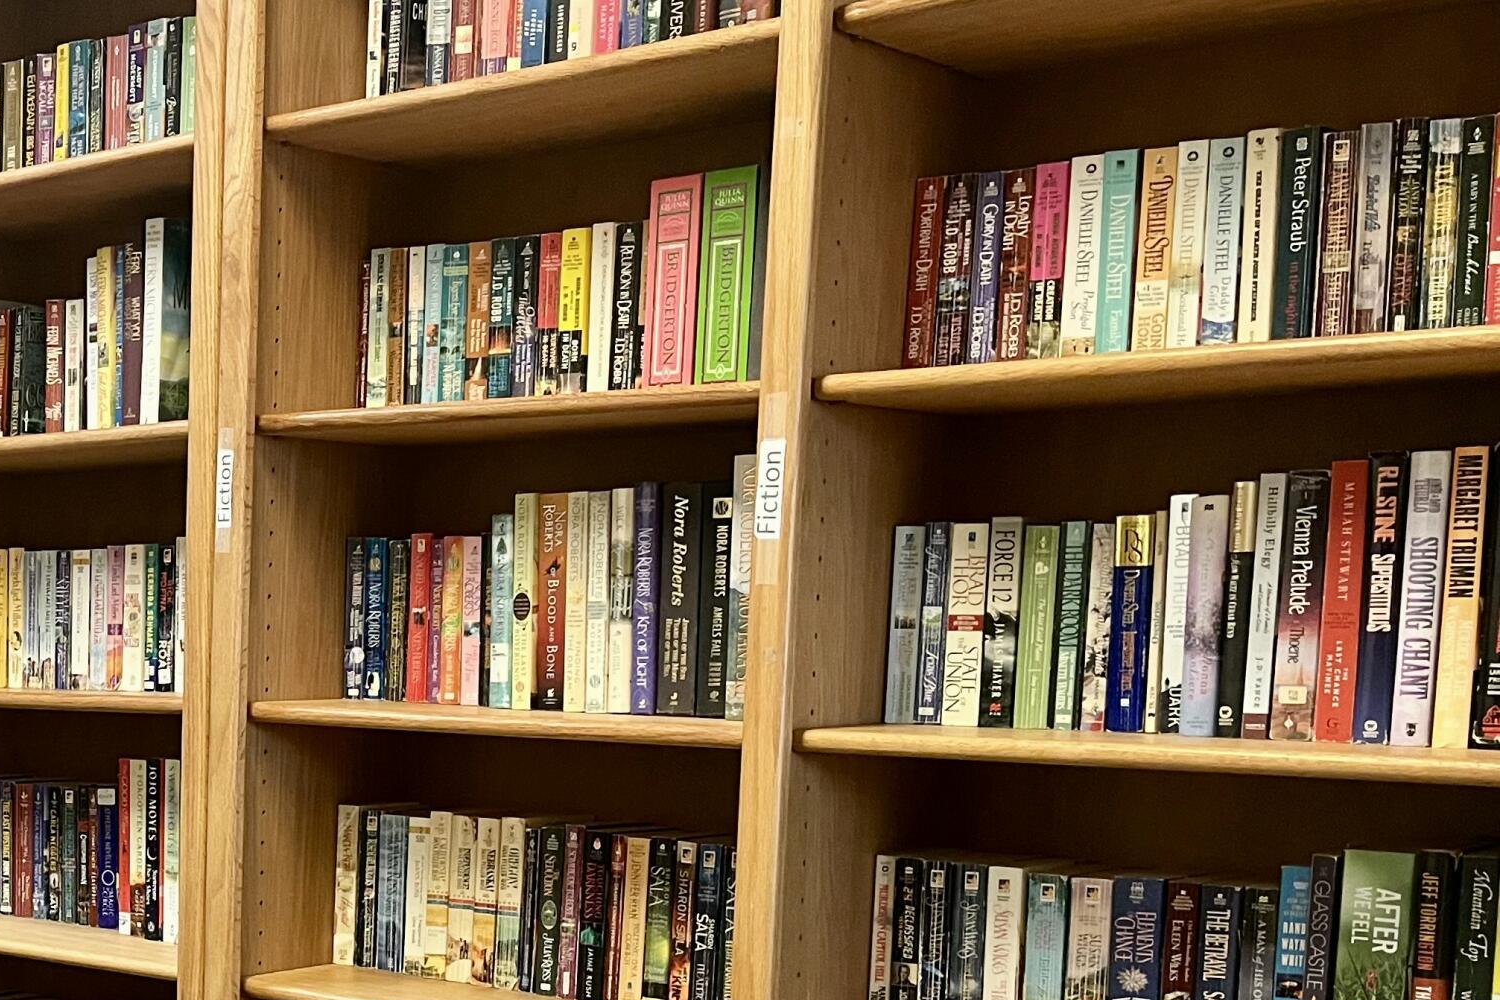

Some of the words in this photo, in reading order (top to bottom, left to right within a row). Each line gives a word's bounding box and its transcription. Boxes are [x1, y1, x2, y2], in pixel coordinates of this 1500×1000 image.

[1292, 157, 1311, 196] Peter
[1078, 190, 1098, 248] DANIELLE
[1108, 194, 1132, 260] DANIELLE
[1146, 175, 1173, 237] DANIELLE
[1217, 175, 1234, 235] DANIELLE
[1290, 199, 1309, 252] Straub
[1003, 215, 1016, 250] DEATH
[1215, 238, 1229, 274] STEEL
[133, 251, 142, 274] FERN
[943, 243, 957, 274] ROBB
[663, 251, 680, 365] BRIDGERTON
[715, 247, 734, 365] BRIDGERTON
[970, 324, 983, 358] ROBB
[1008, 315, 1022, 358] ROBB
[46, 347, 62, 385] MICHAELS
[217, 453, 231, 523] Fiction
[757, 450, 782, 534] Fiction
[1263, 487, 1278, 534] Hillbilly
[1342, 482, 1355, 535] MARIAH
[1453, 454, 1483, 531] MARGARET
[543, 504, 556, 553] ROBERTS
[555, 510, 566, 546] NORA
[673, 495, 689, 538] Nora
[715, 526, 729, 552] NORA
[1293, 505, 1317, 557] Vienna
[1374, 496, 1396, 543] STINE
[638, 528, 653, 554] NORA
[992, 530, 1015, 582] FORCE
[1262, 538, 1275, 570] Elegy
[635, 557, 652, 605] ROBERTS
[672, 542, 689, 606] Roberts
[713, 556, 727, 597] ROBERTS
[951, 559, 969, 609] THOR
[968, 554, 986, 606] BRAD
[1289, 558, 1313, 614] Prelude
[1337, 540, 1350, 600] STEWART
[1405, 536, 1439, 630] SHOOTING
[1448, 538, 1477, 598] TRUMAN
[369, 582, 381, 608] NORA
[548, 579, 559, 628] BLOOD
[992, 589, 1012, 603] 12
[1367, 554, 1396, 633] SUPERSTITIOUS
[366, 611, 381, 648] ROBERTS
[712, 606, 724, 637] ANGELS
[546, 645, 558, 679] BONE
[710, 639, 722, 657] FALL
[962, 646, 977, 693] STATE
[1400, 638, 1431, 699] CHANT
[636, 656, 647, 688] LIGHT
[945, 652, 962, 713] UNION
[991, 661, 1003, 698] THAYER
[149, 766, 157, 795] JOJO
[148, 800, 157, 841] MOYES
[650, 866, 665, 906] SALA
[676, 870, 688, 922] SHARON
[1311, 880, 1330, 930] GLASS
[1354, 886, 1372, 911] WE
[1422, 872, 1438, 895] JEFF
[1469, 869, 1493, 930] Mountain
[695, 913, 709, 951] SALA
[1206, 910, 1230, 933] THE
[1351, 914, 1370, 944] FELL
[1372, 887, 1401, 954] AFTER
[1418, 899, 1438, 971] TORRINGTON
[1203, 934, 1229, 981] BETRAYAL
[1307, 932, 1327, 991] CASTLE
[1461, 934, 1487, 963] Top
